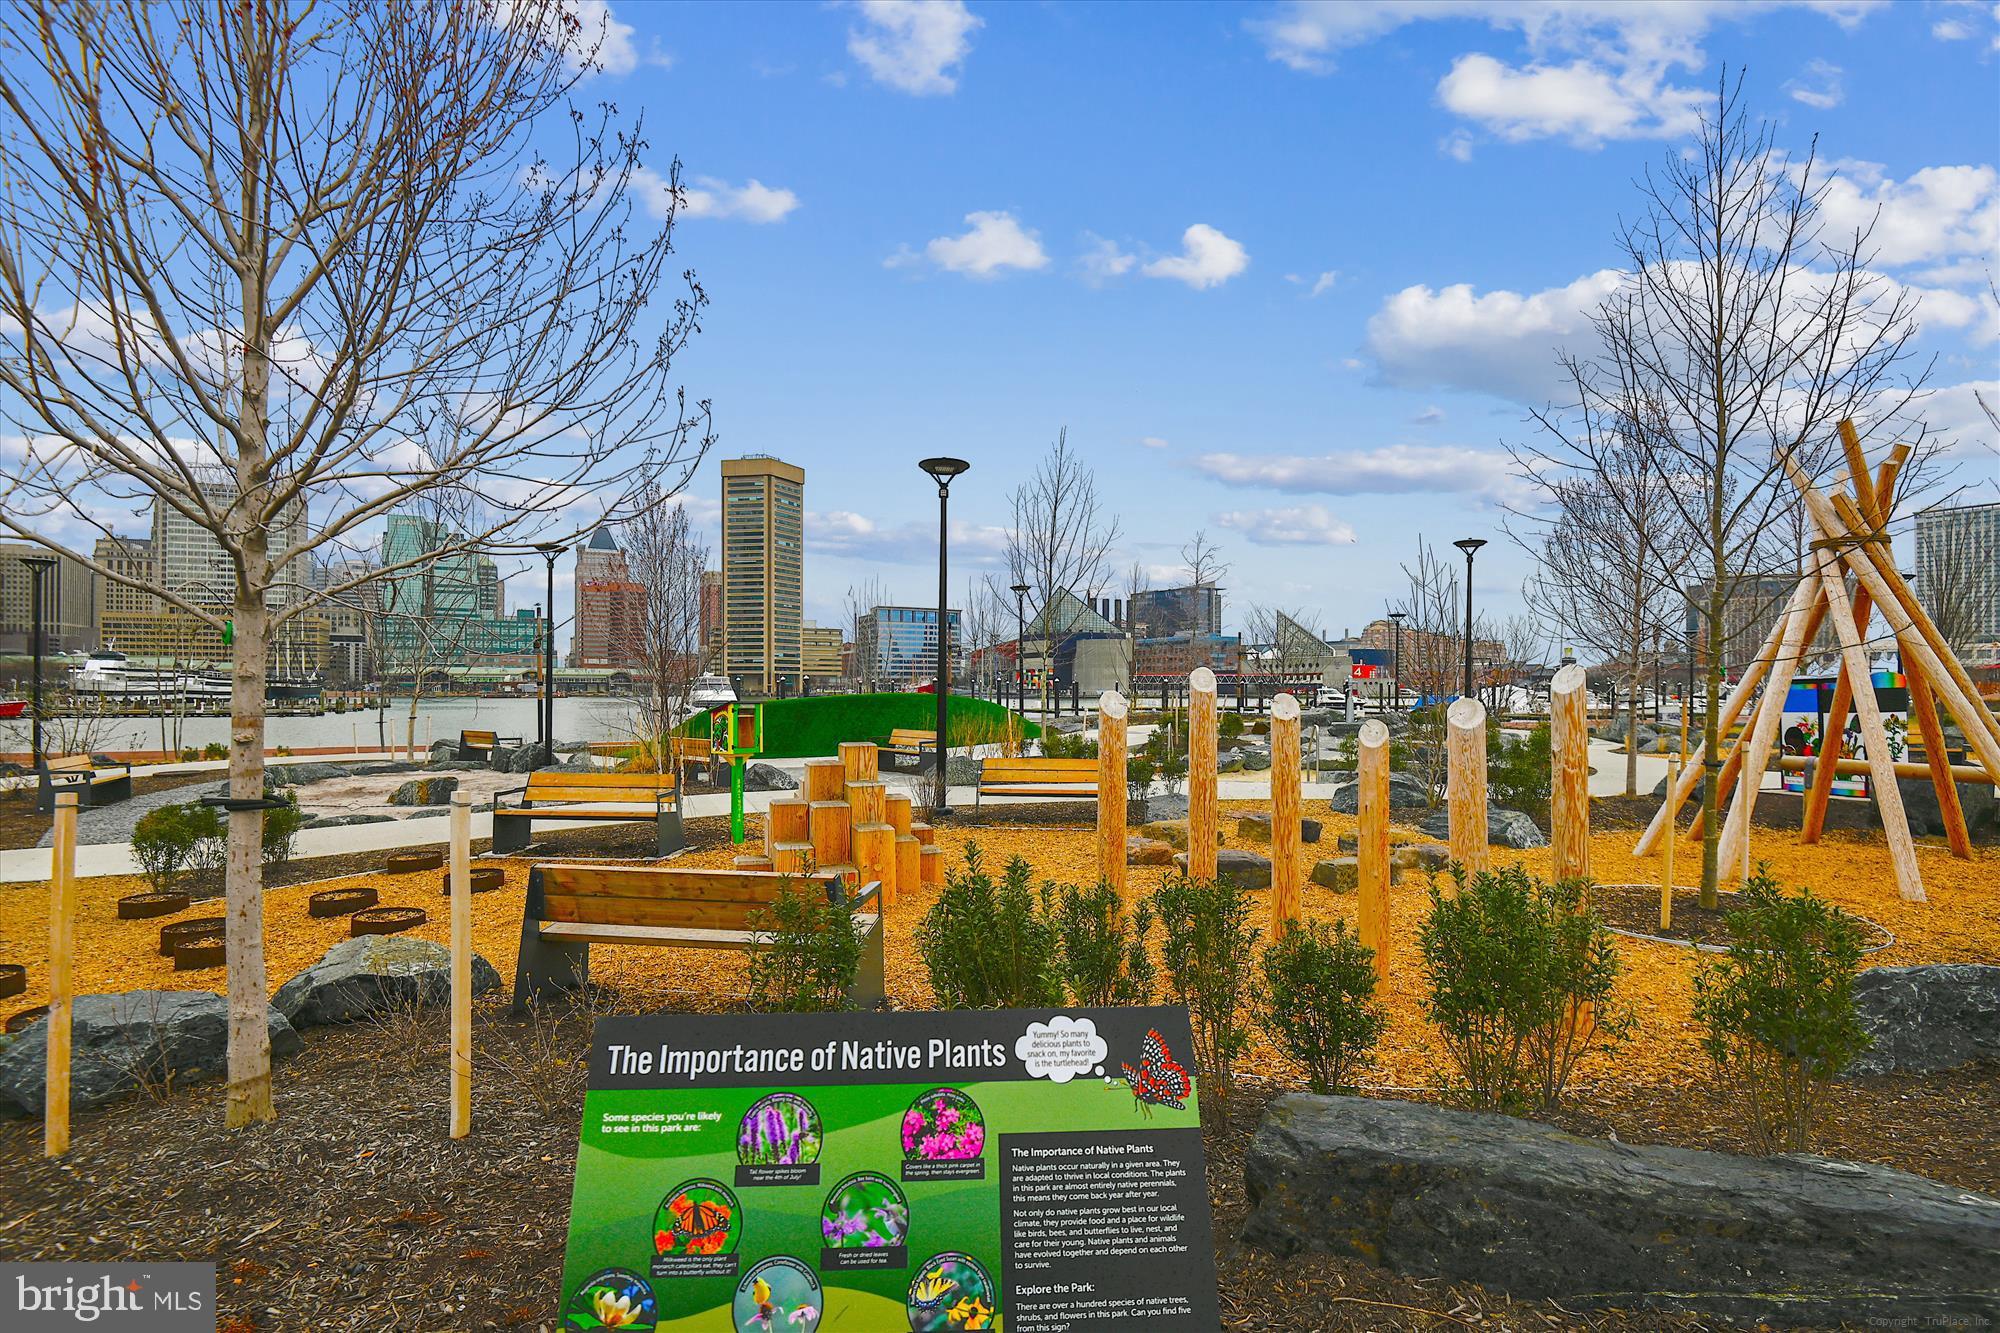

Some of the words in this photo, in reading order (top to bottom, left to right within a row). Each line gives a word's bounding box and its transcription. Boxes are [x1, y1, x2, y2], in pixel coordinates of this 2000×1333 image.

[1354, 667, 1362, 676] 4
[1060, 1030, 1069, 1038] So
[1062, 1040, 1082, 1049] plants
[608, 1045, 652, 1074] The
[658, 1044, 804, 1080] Importance
[811, 1041, 836, 1071] of
[842, 1040, 921, 1070] Native
[928, 1038, 1006, 1068] Plants
[1059, 1051, 1070, 1059] my
[602, 1113, 630, 1122] Some
[631, 1113, 665, 1122] species
[666, 1112, 696, 1122] you're
[697, 1112, 722, 1121] likely
[631, 1124, 640, 1132] in
[642, 1124, 659, 1132] this
[660, 1124, 682, 1133] park
[1011, 1148, 1029, 1157] The
[1031, 1148, 1083, 1158] Importance
[1084, 1146, 1094, 1155] of
[1096, 1146, 1124, 1154] Native
[1126, 1145, 1154, 1153] Plants
[1125, 1161, 1144, 1169] given
[1163, 1160, 1180, 1168] They
[1028, 1209, 1044, 1218] only
[1060, 1218, 1087, 1226] provide
[1112, 1237, 1133, 1245] plants
[1062, 1249, 1094, 1258] together
[1016, 1285, 1052, 1295] Explore
[1053, 1284, 1069, 1293] the
[1071, 1283, 1095, 1292] Park:
[1108, 1299, 1135, 1307] species
[1051, 1323, 1070, 1332] sign?
